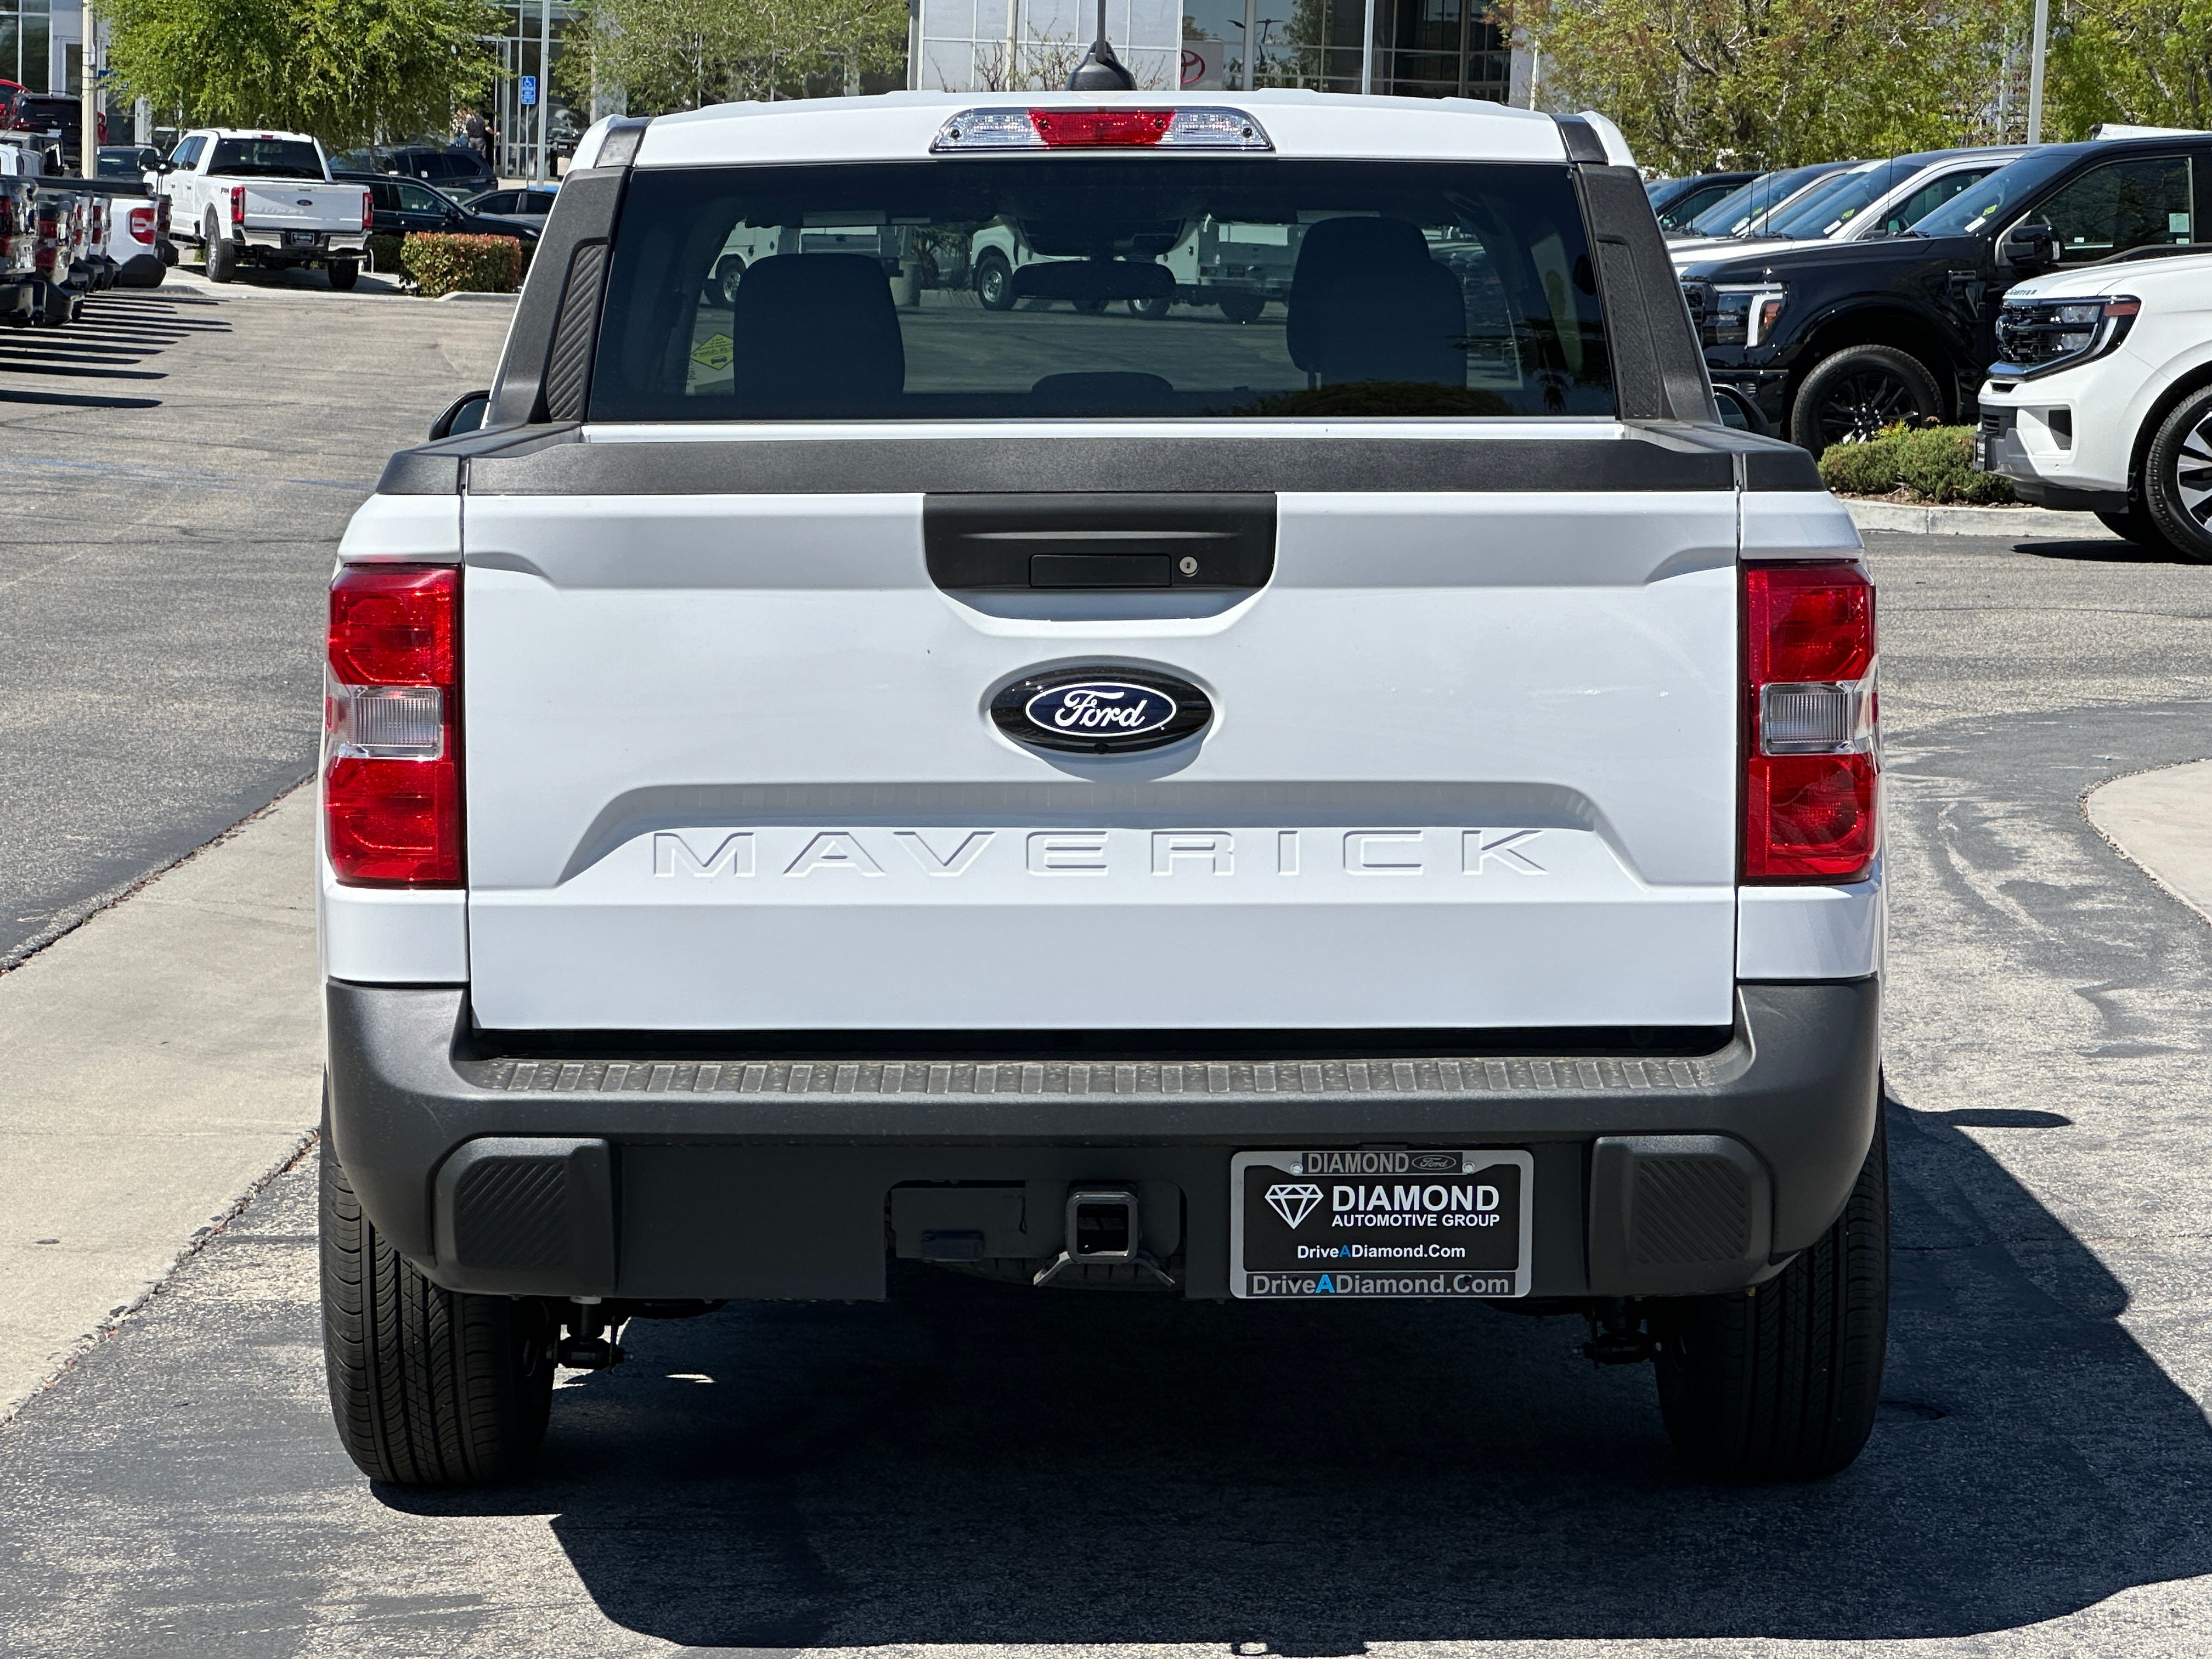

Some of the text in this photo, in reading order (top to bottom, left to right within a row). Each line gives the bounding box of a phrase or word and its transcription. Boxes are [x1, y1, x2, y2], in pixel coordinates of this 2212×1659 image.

[1054, 690, 1148, 727] Ford
[653, 829, 1549, 878] MAVERICK
[1307, 1153, 1449, 1173] DIAMOND Ford
[1332, 1185, 1499, 1211] DIAMOND
[1331, 1214, 1500, 1227] AUTOMOTIVE GROUP
[1297, 1244, 1466, 1259] DriveADiamond.Com
[1253, 1274, 1509, 1294] DriveADiamond.Com
